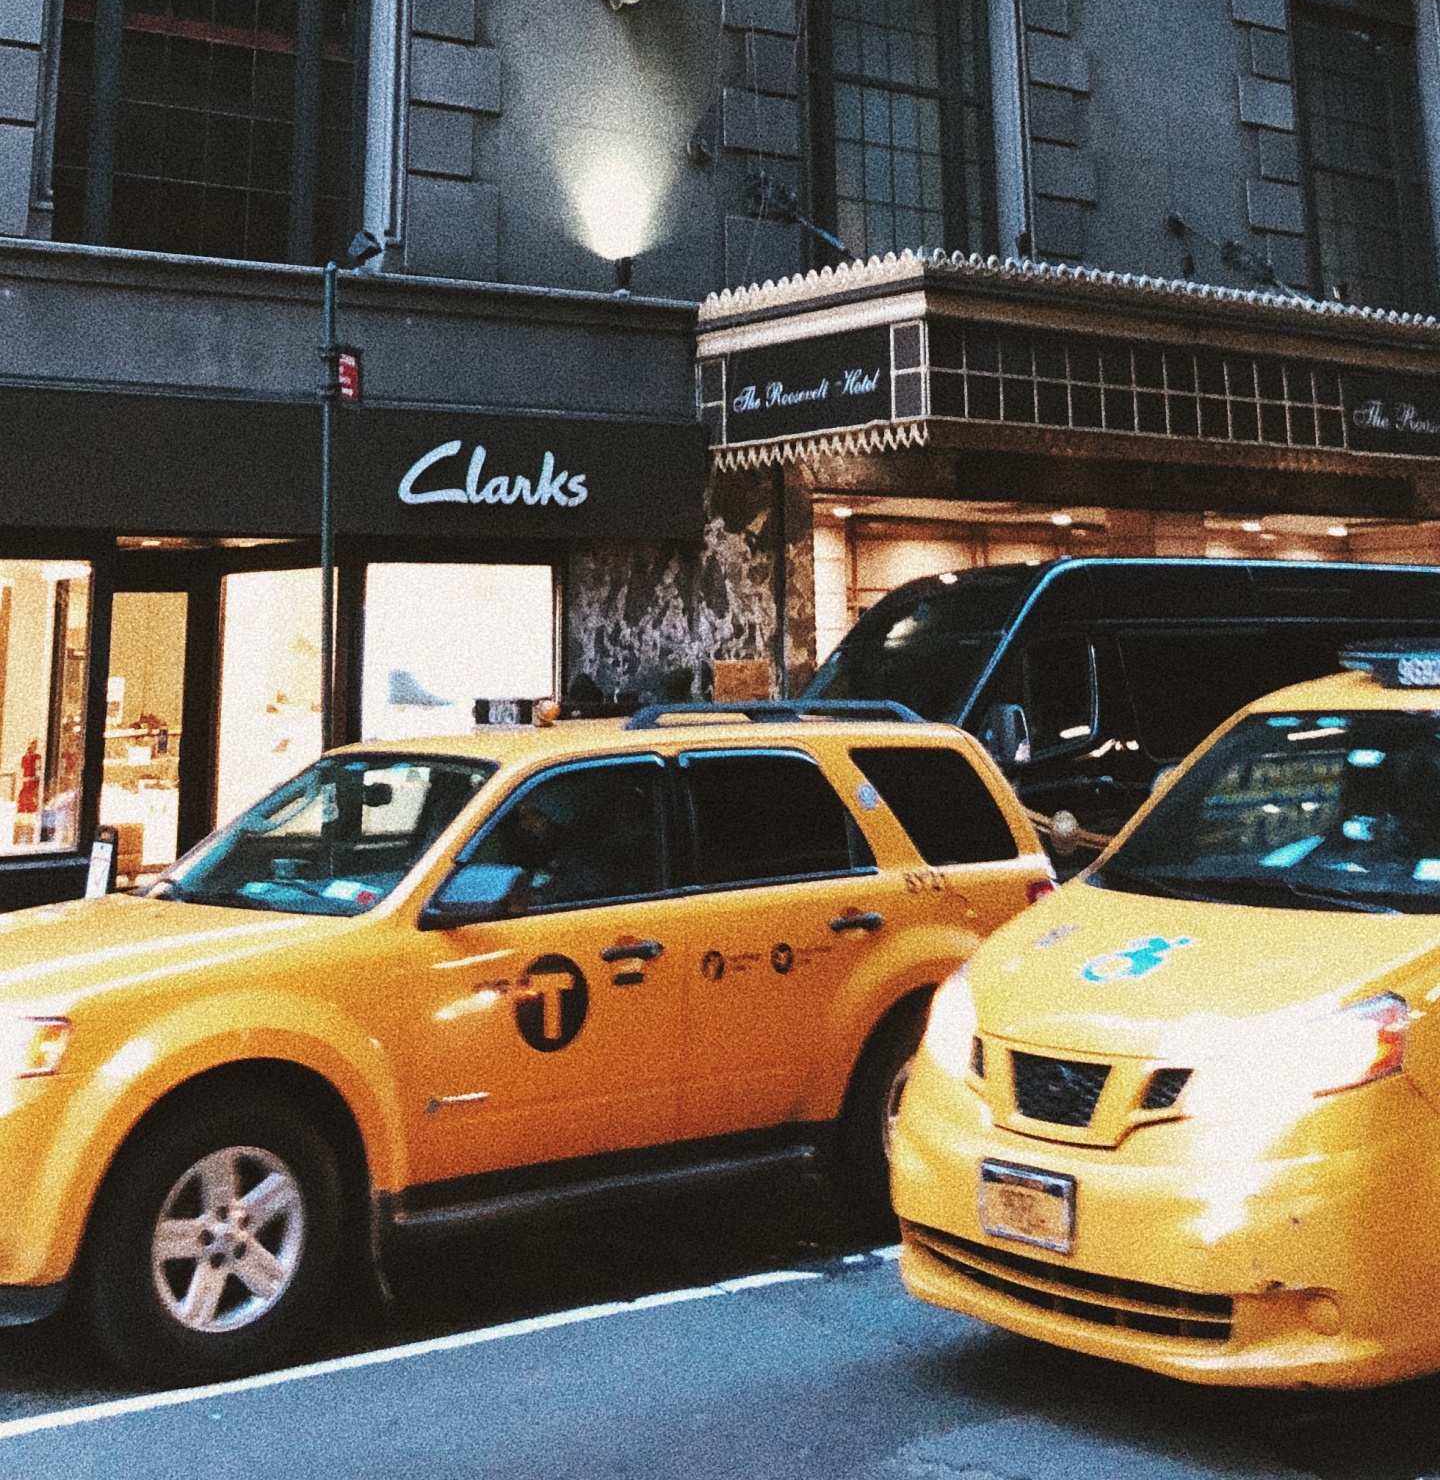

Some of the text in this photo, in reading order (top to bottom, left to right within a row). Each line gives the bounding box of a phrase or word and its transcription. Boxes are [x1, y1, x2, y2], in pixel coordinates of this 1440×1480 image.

[733, 368, 880, 413] The Roosevelt Hotel
[1353, 400, 1391, 429] The
[398, 440, 589, 507] Clarks
